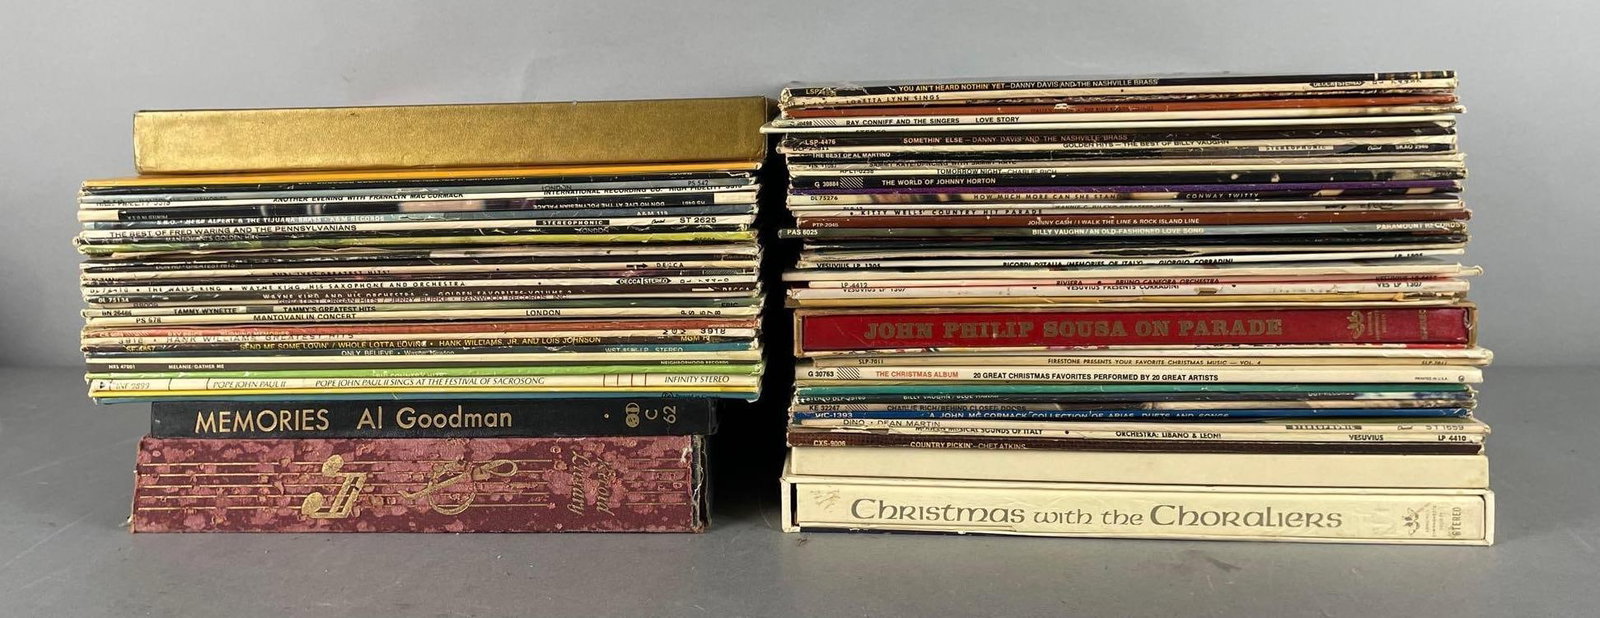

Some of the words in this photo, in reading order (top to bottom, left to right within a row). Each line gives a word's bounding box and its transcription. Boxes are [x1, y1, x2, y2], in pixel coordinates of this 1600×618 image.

[864, 322, 934, 340] JOHN
[942, 322, 1034, 339] PHILIP
[1044, 320, 1128, 337] SOUSA
[1135, 320, 1170, 336] ON
[1178, 319, 1282, 336] PARADE
[194, 409, 329, 433] MEMORIES
[356, 406, 382, 430] Al
[396, 405, 512, 432] Goodman
[851, 498, 1025, 524] Christmas
[1034, 508, 1093, 525] with
[1101, 509, 1143, 526] the
[1150, 505, 1342, 528] Choraliers
